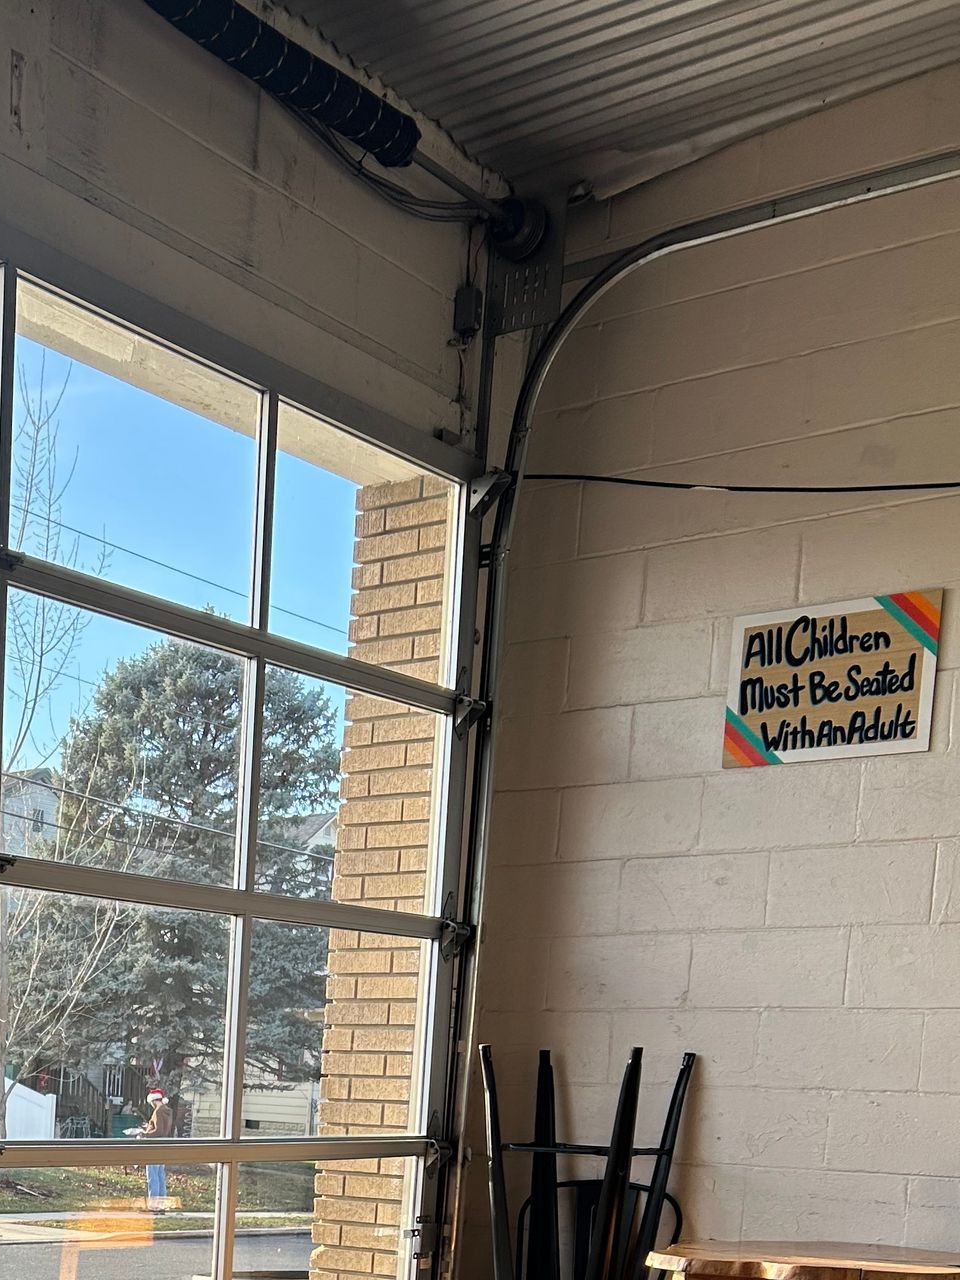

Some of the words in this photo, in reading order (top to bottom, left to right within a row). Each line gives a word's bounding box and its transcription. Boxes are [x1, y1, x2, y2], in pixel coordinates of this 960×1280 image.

[744, 626, 783, 669] All
[785, 615, 891, 667] Children
[740, 672, 805, 716] Must
[809, 670, 842, 706] Be
[844, 652, 916, 701] Seated
[760, 715, 815, 751] With
[816, 720, 846, 747] An
[846, 703, 916, 745] Adult
